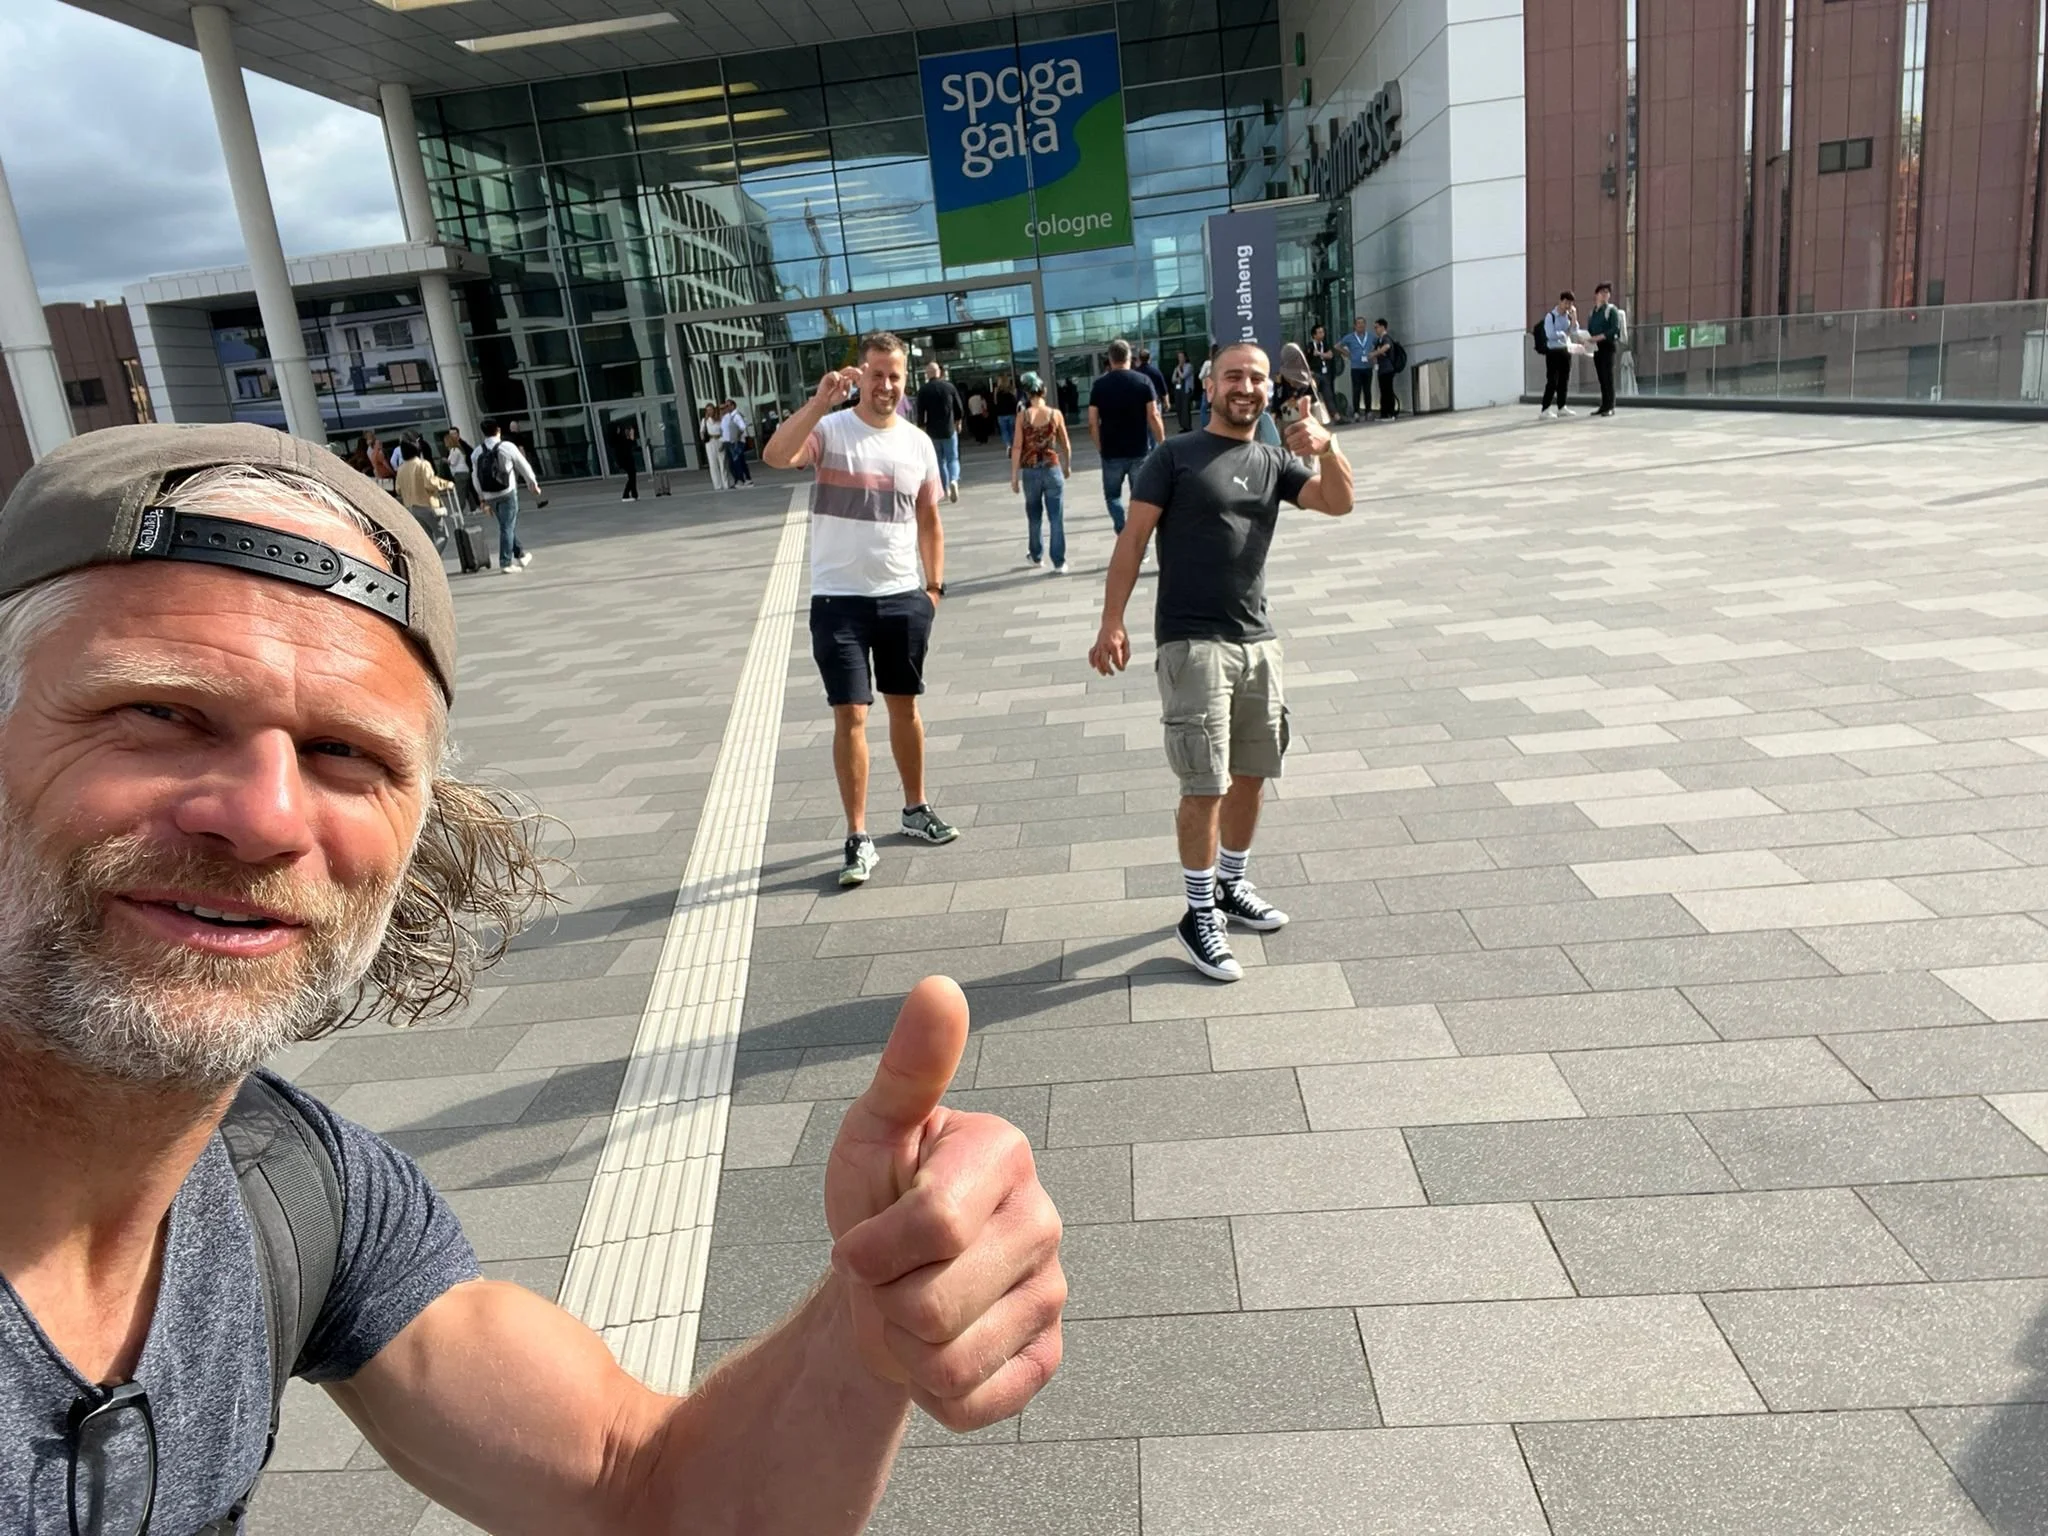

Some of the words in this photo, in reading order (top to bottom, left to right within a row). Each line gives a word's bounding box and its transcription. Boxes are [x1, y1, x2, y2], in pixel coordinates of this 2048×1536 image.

[942, 58, 1084, 124] spoga
[961, 103, 1059, 178] gafa
[1024, 211, 1113, 238] cologne
[1236, 244, 1254, 321] Jiaheng
[141, 511, 157, 535] Dutch
